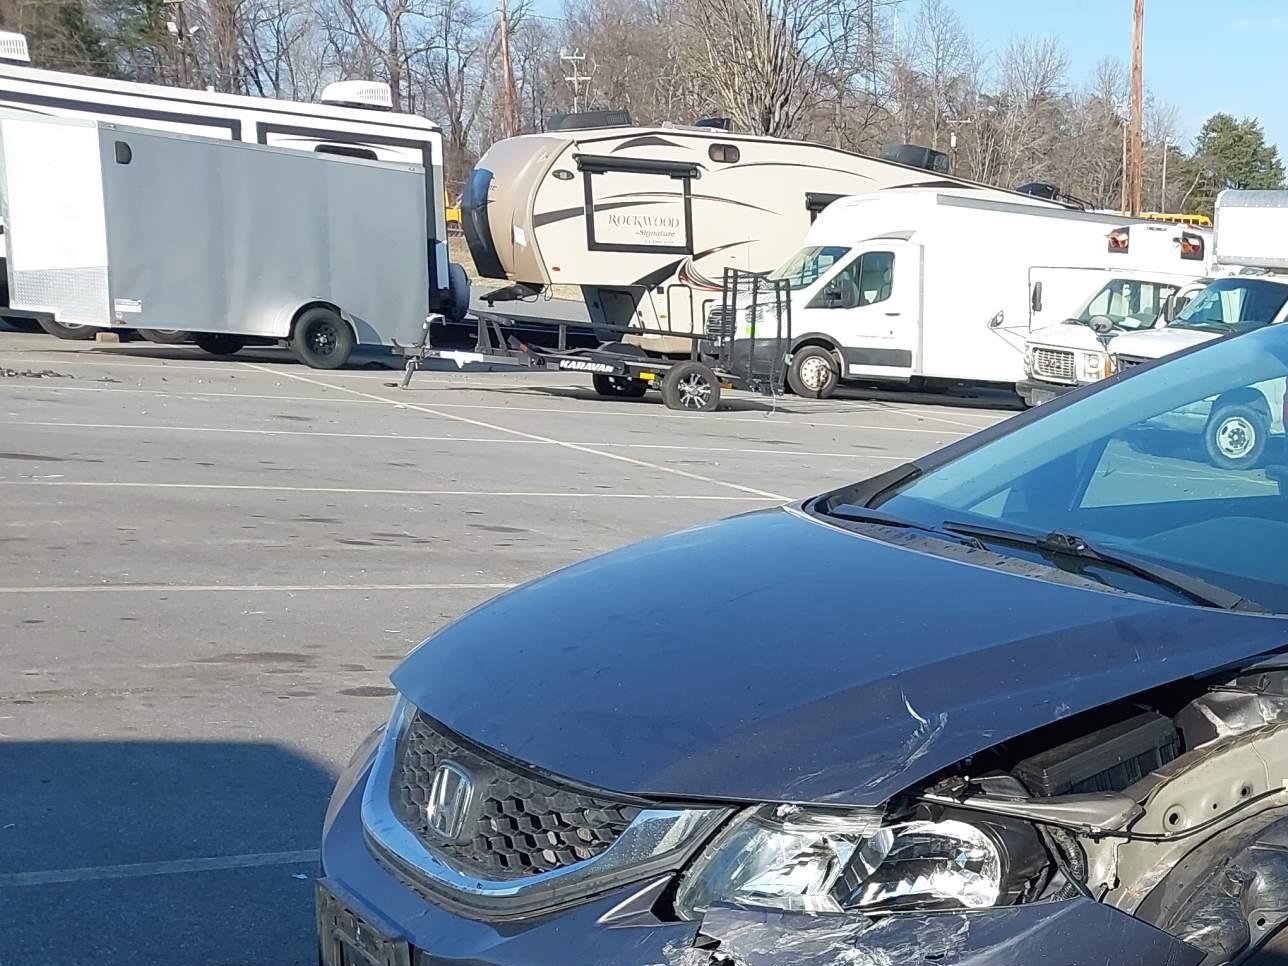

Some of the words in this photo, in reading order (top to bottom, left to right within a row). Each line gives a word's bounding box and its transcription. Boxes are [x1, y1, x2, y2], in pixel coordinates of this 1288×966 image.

[608, 214, 680, 229] ROCKWOOD
[638, 229, 676, 237] Signature
[560, 360, 615, 373] KARAVAN
